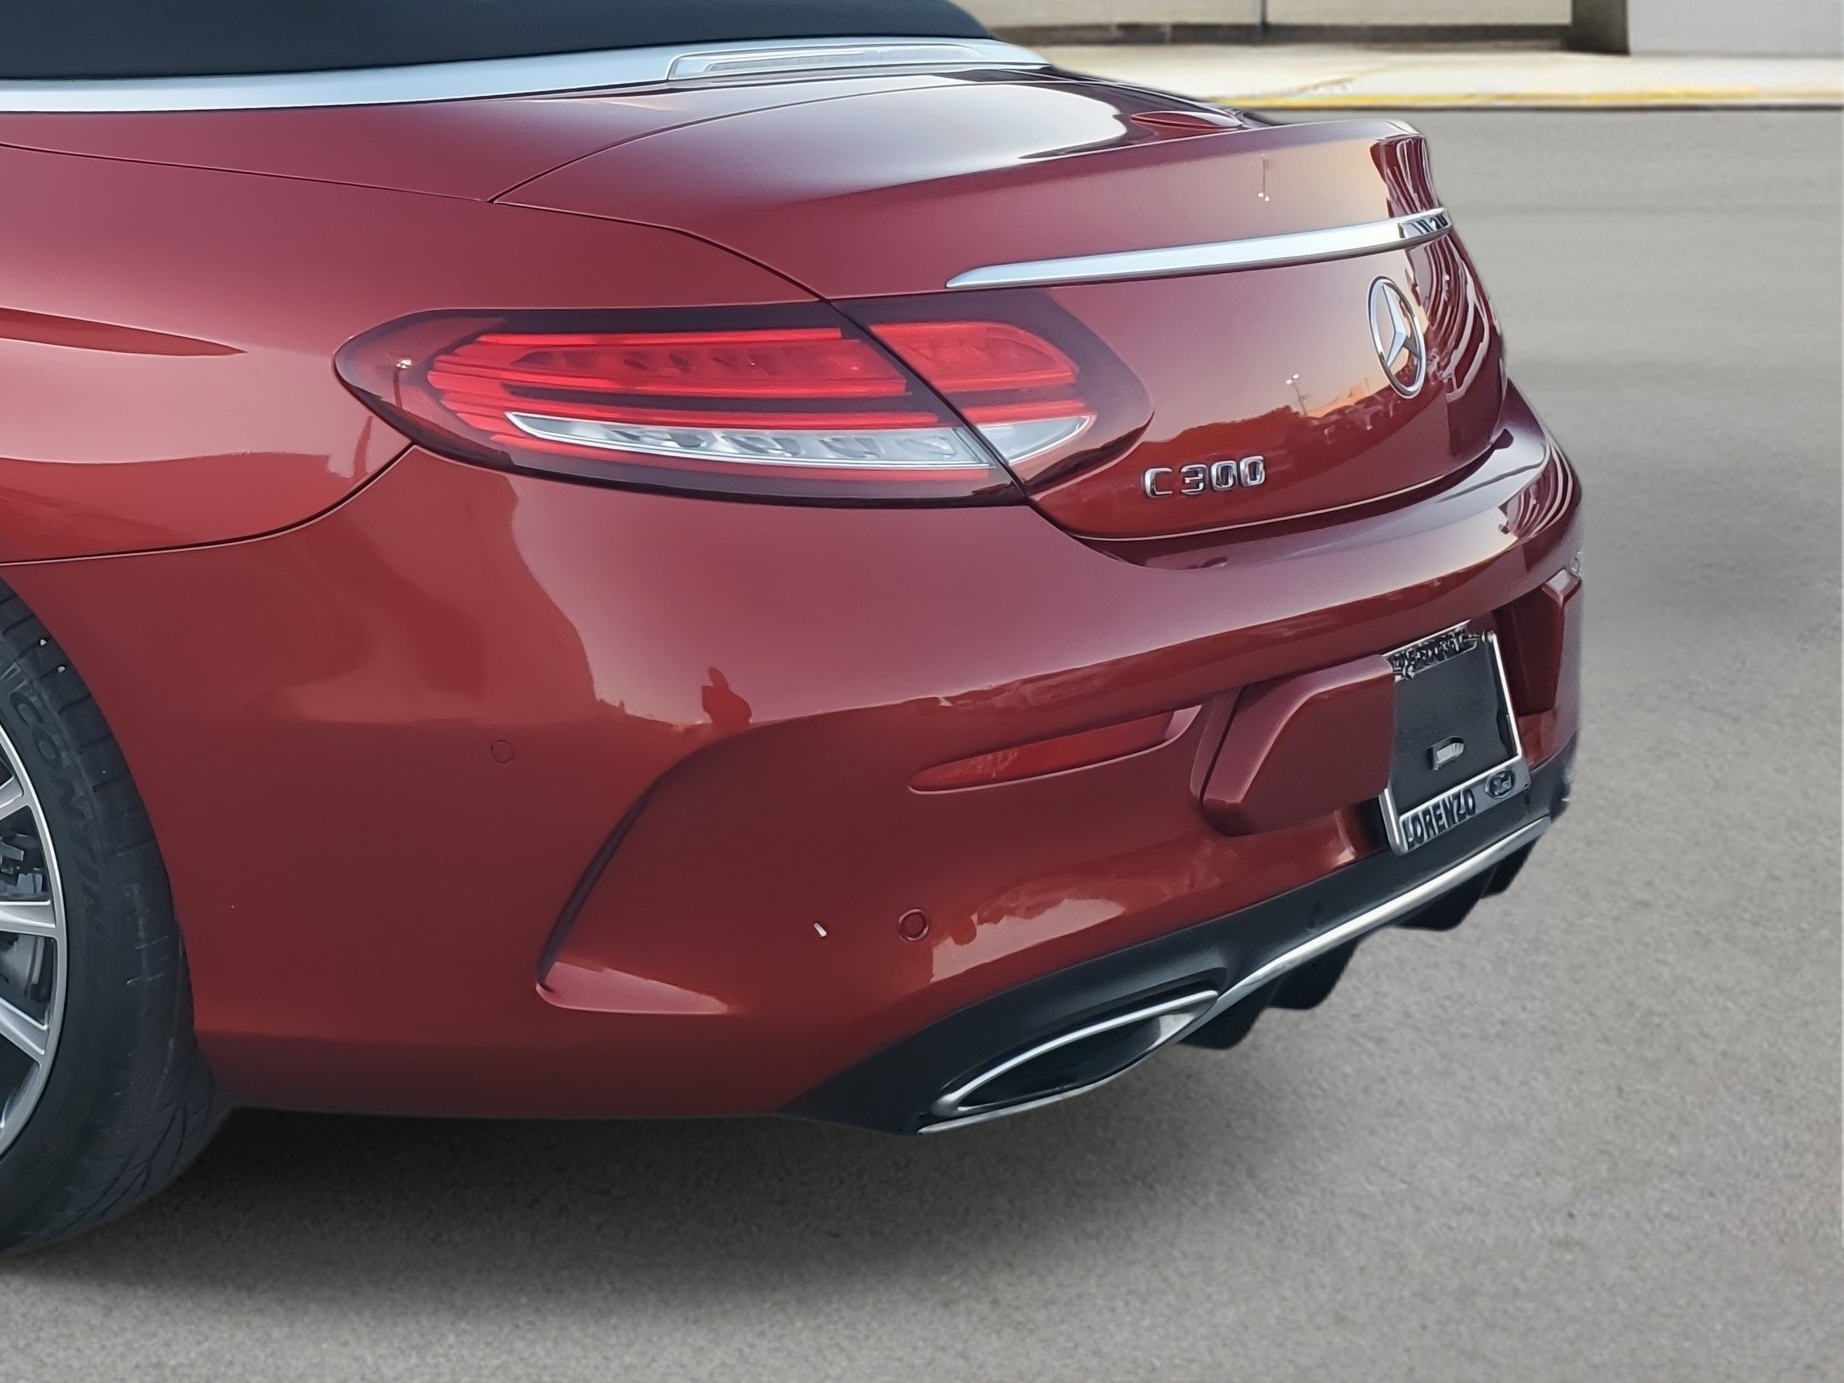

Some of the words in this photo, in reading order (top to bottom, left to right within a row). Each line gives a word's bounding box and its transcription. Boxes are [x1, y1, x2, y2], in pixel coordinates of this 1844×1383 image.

[1143, 467, 1173, 499] C
[1180, 455, 1266, 495] 300
[1401, 788, 1477, 850] LORENZO
